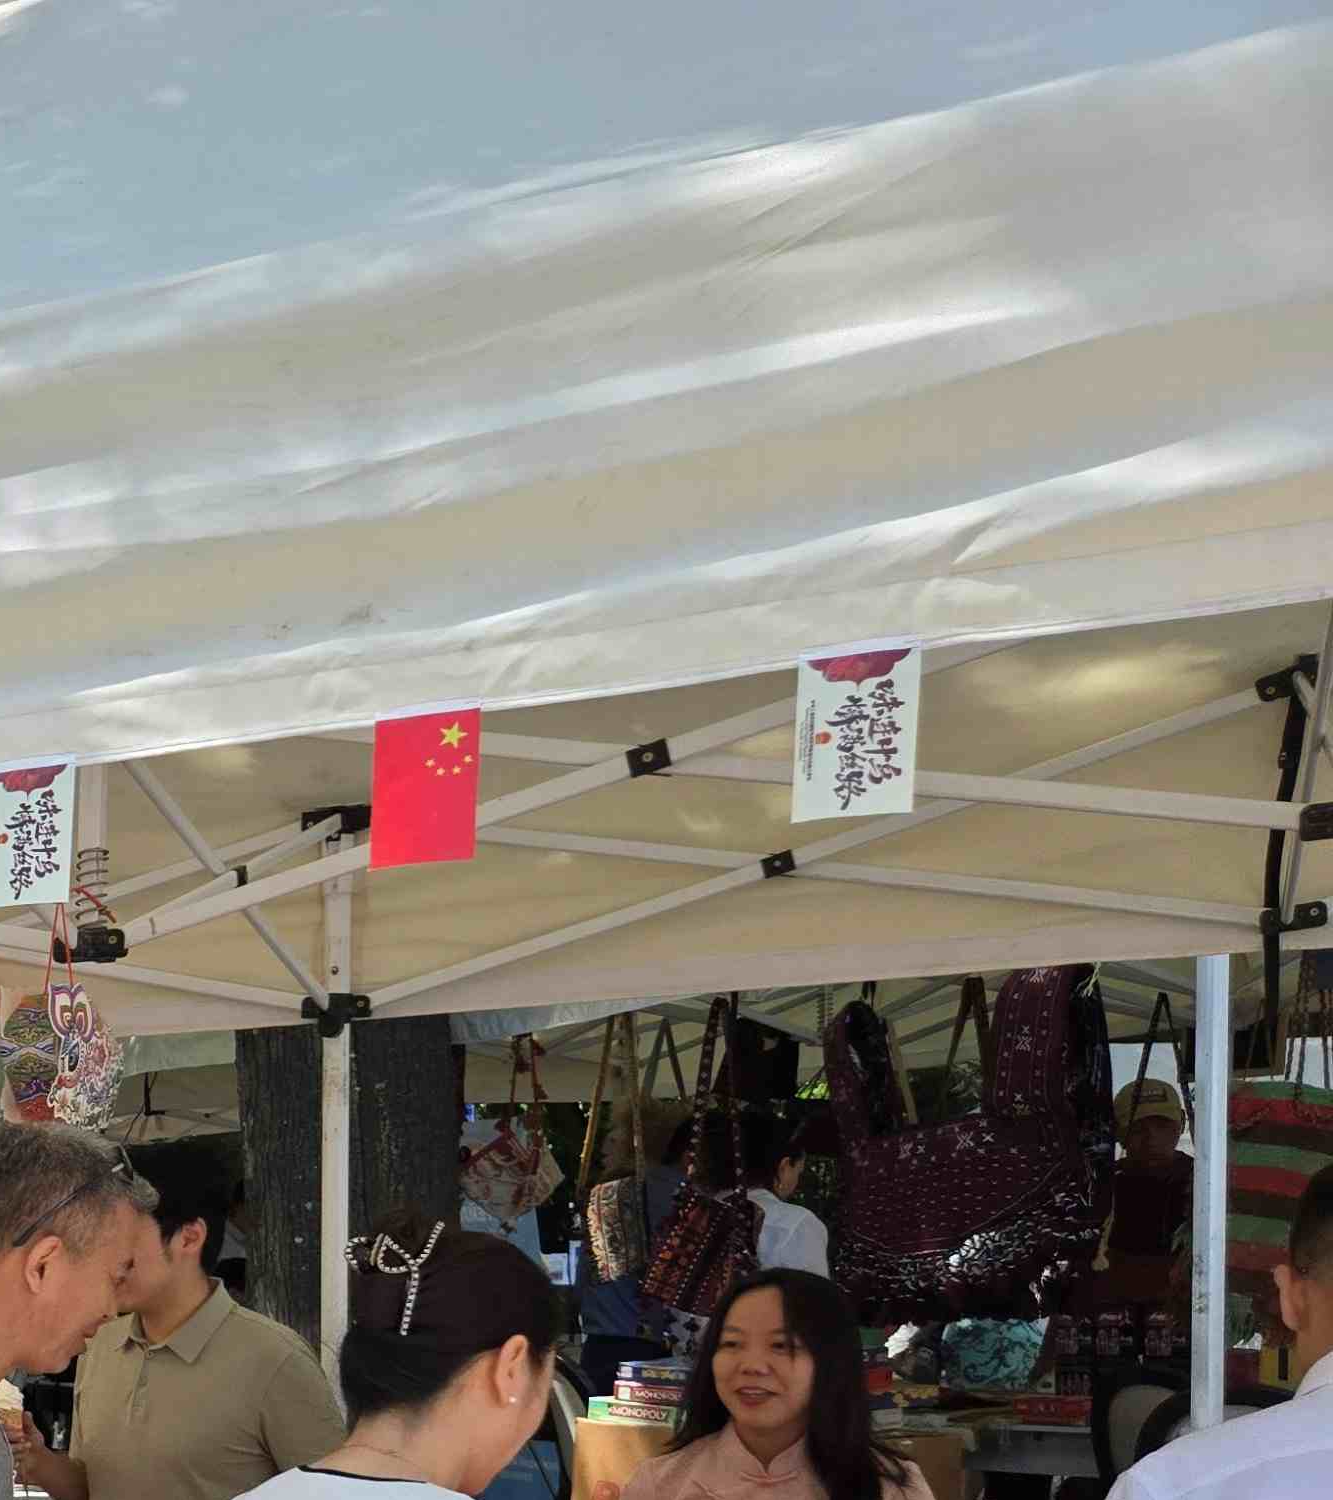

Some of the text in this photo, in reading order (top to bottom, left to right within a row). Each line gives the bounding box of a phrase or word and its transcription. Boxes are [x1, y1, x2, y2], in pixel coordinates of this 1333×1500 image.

[825, 695, 870, 810] 情满丝路
[862, 679, 905, 784] 味连中乌
[610, 1405, 668, 1420] MONOPOLY
